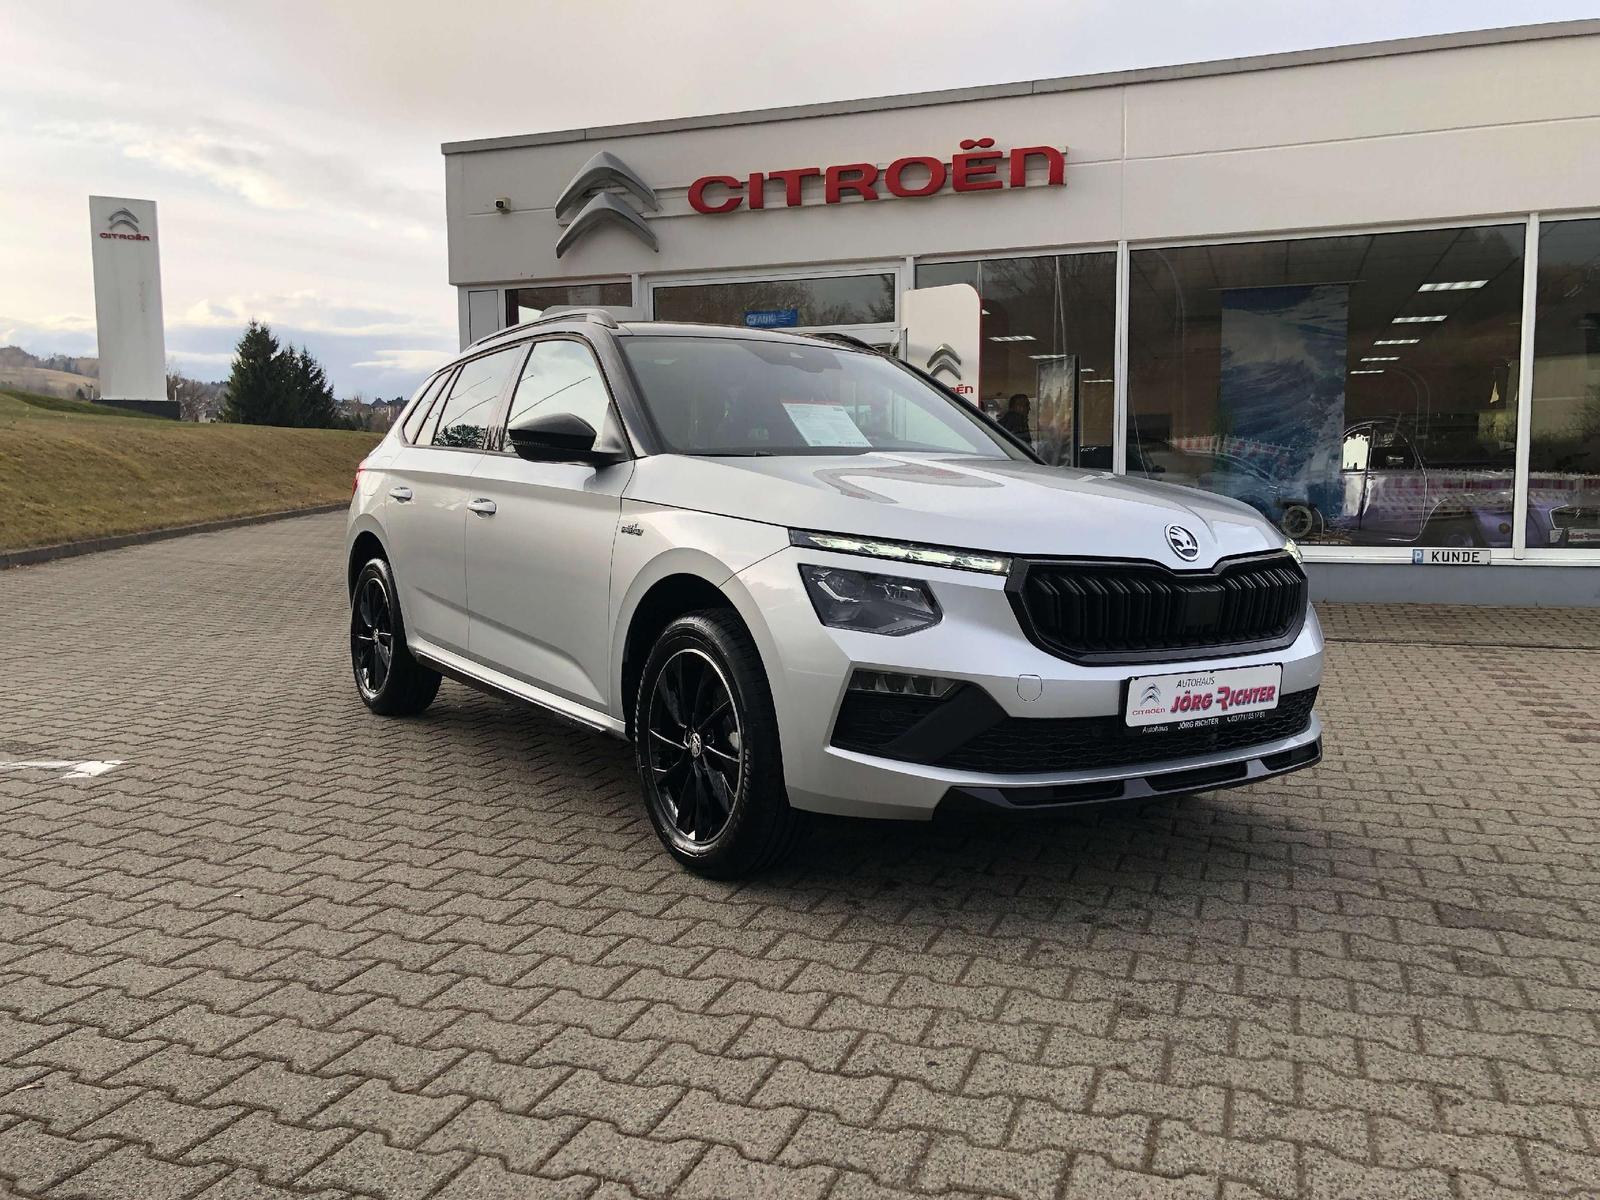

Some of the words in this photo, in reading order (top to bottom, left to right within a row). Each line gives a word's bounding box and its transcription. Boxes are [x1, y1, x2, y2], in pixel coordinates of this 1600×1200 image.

[688, 138, 1066, 214] CITROËN
[1431, 551, 1480, 563] KUNDE
[1176, 676, 1215, 688] AUTOHAUS
[1170, 690, 1212, 713] JÖRG
[1216, 686, 1275, 711] RICHTER
[1142, 725, 1169, 734] Autohaus
[1194, 717, 1219, 728] RICHTER
